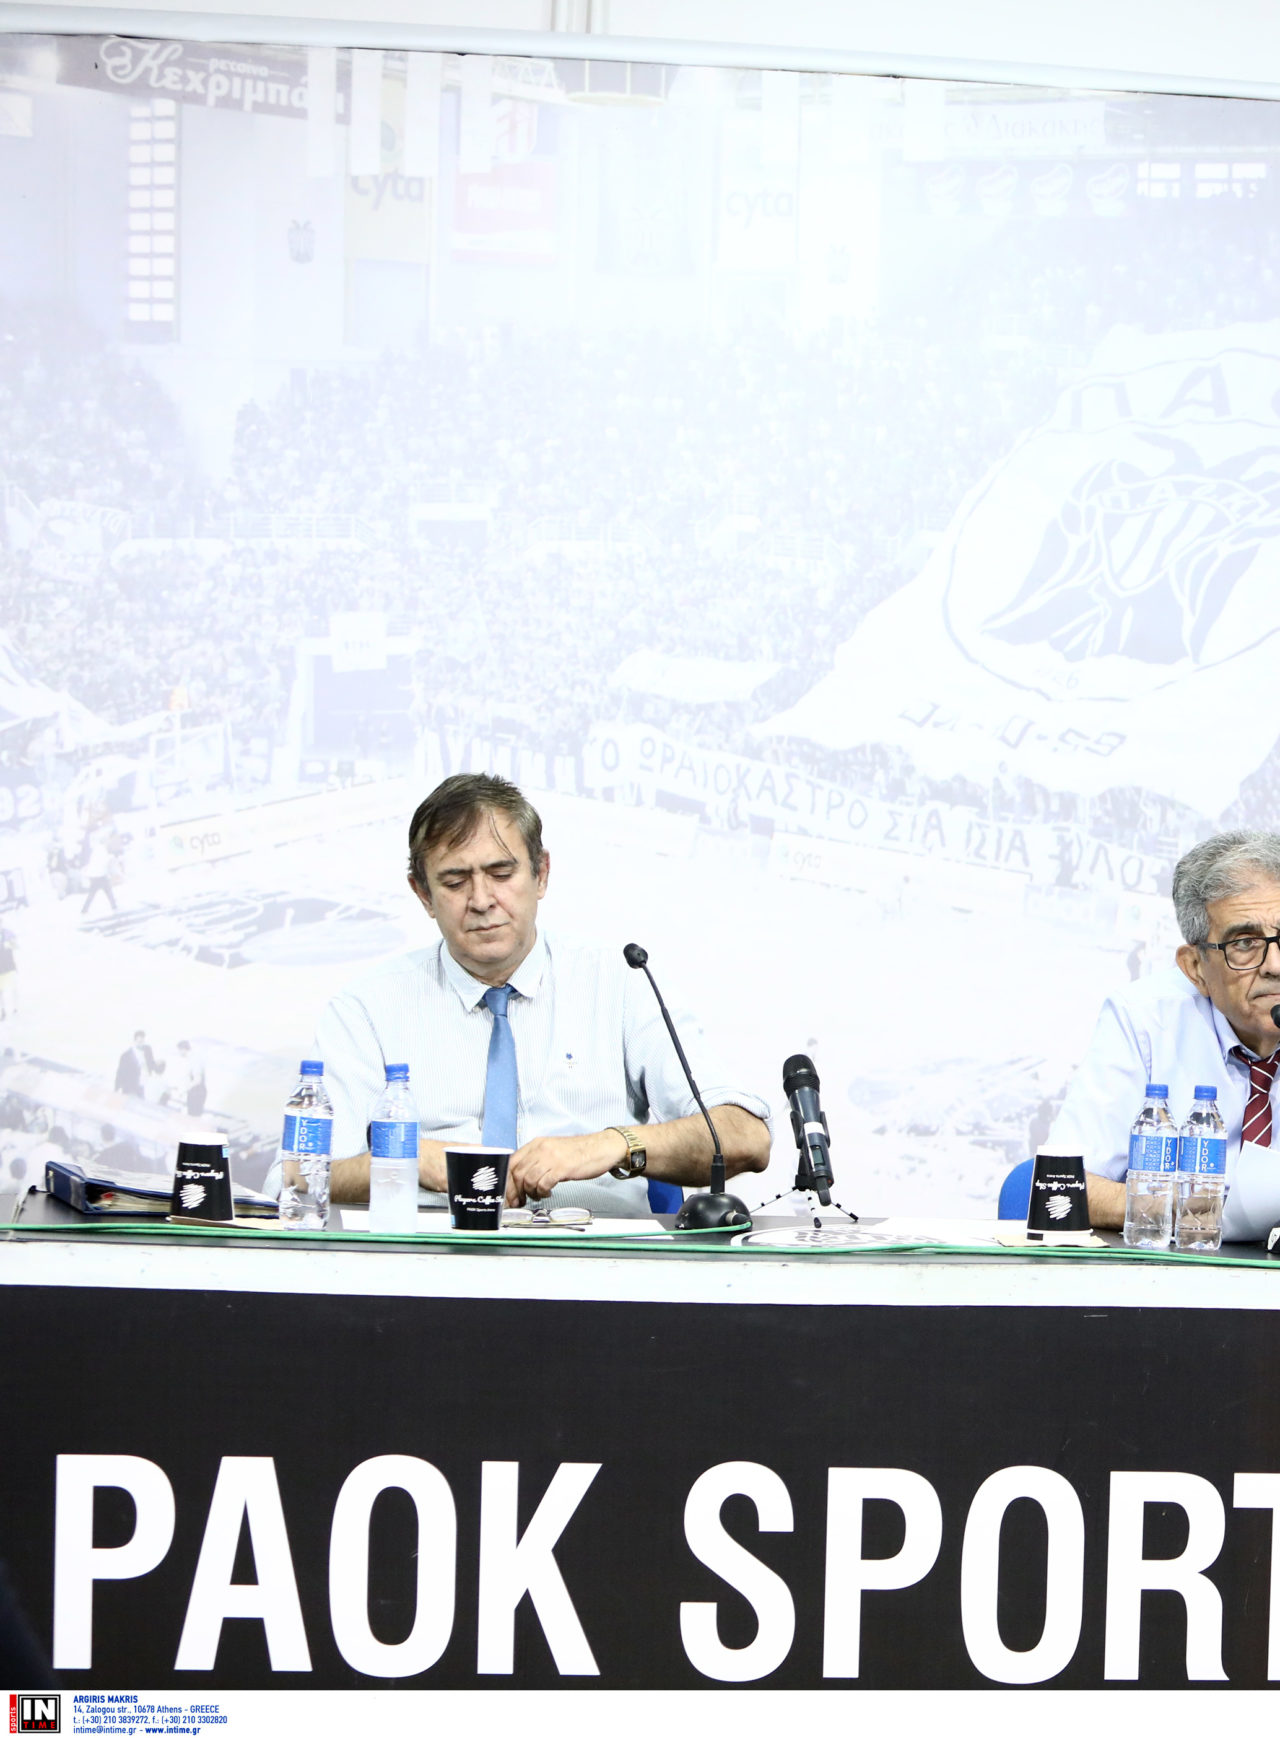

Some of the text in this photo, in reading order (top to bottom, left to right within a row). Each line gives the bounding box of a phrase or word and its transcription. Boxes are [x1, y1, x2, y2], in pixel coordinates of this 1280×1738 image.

[100, 38, 344, 114] Κεχριμπάι
[725, 187, 794, 229] cyta
[54, 1454, 602, 1677] PAOK
